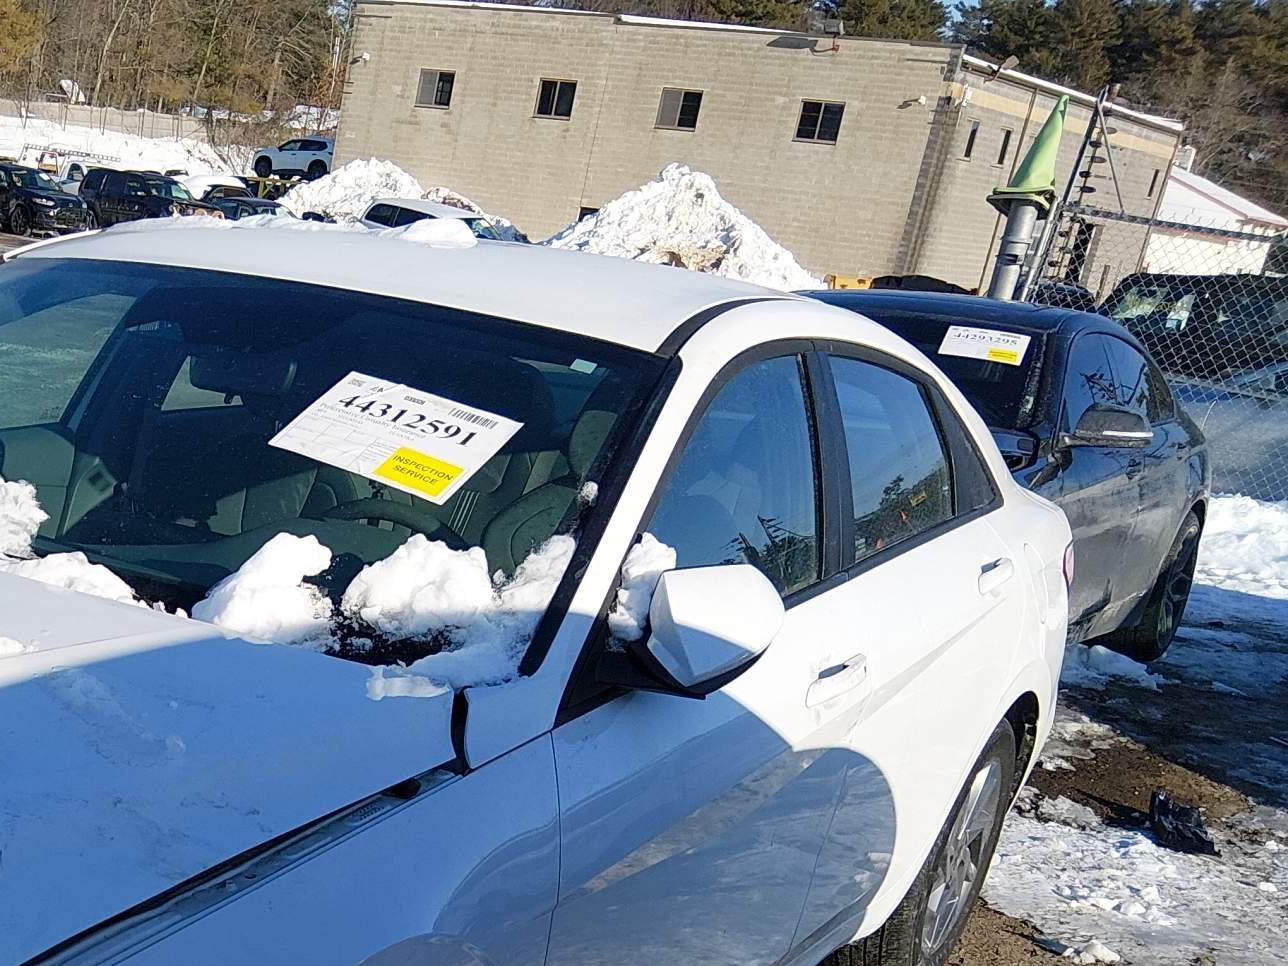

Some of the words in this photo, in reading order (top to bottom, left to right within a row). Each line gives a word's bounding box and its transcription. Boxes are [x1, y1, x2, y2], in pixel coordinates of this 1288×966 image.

[339, 395, 478, 448] 44312591
[393, 455, 453, 481] INSPECTION
[393, 464, 438, 485] SERVICE
